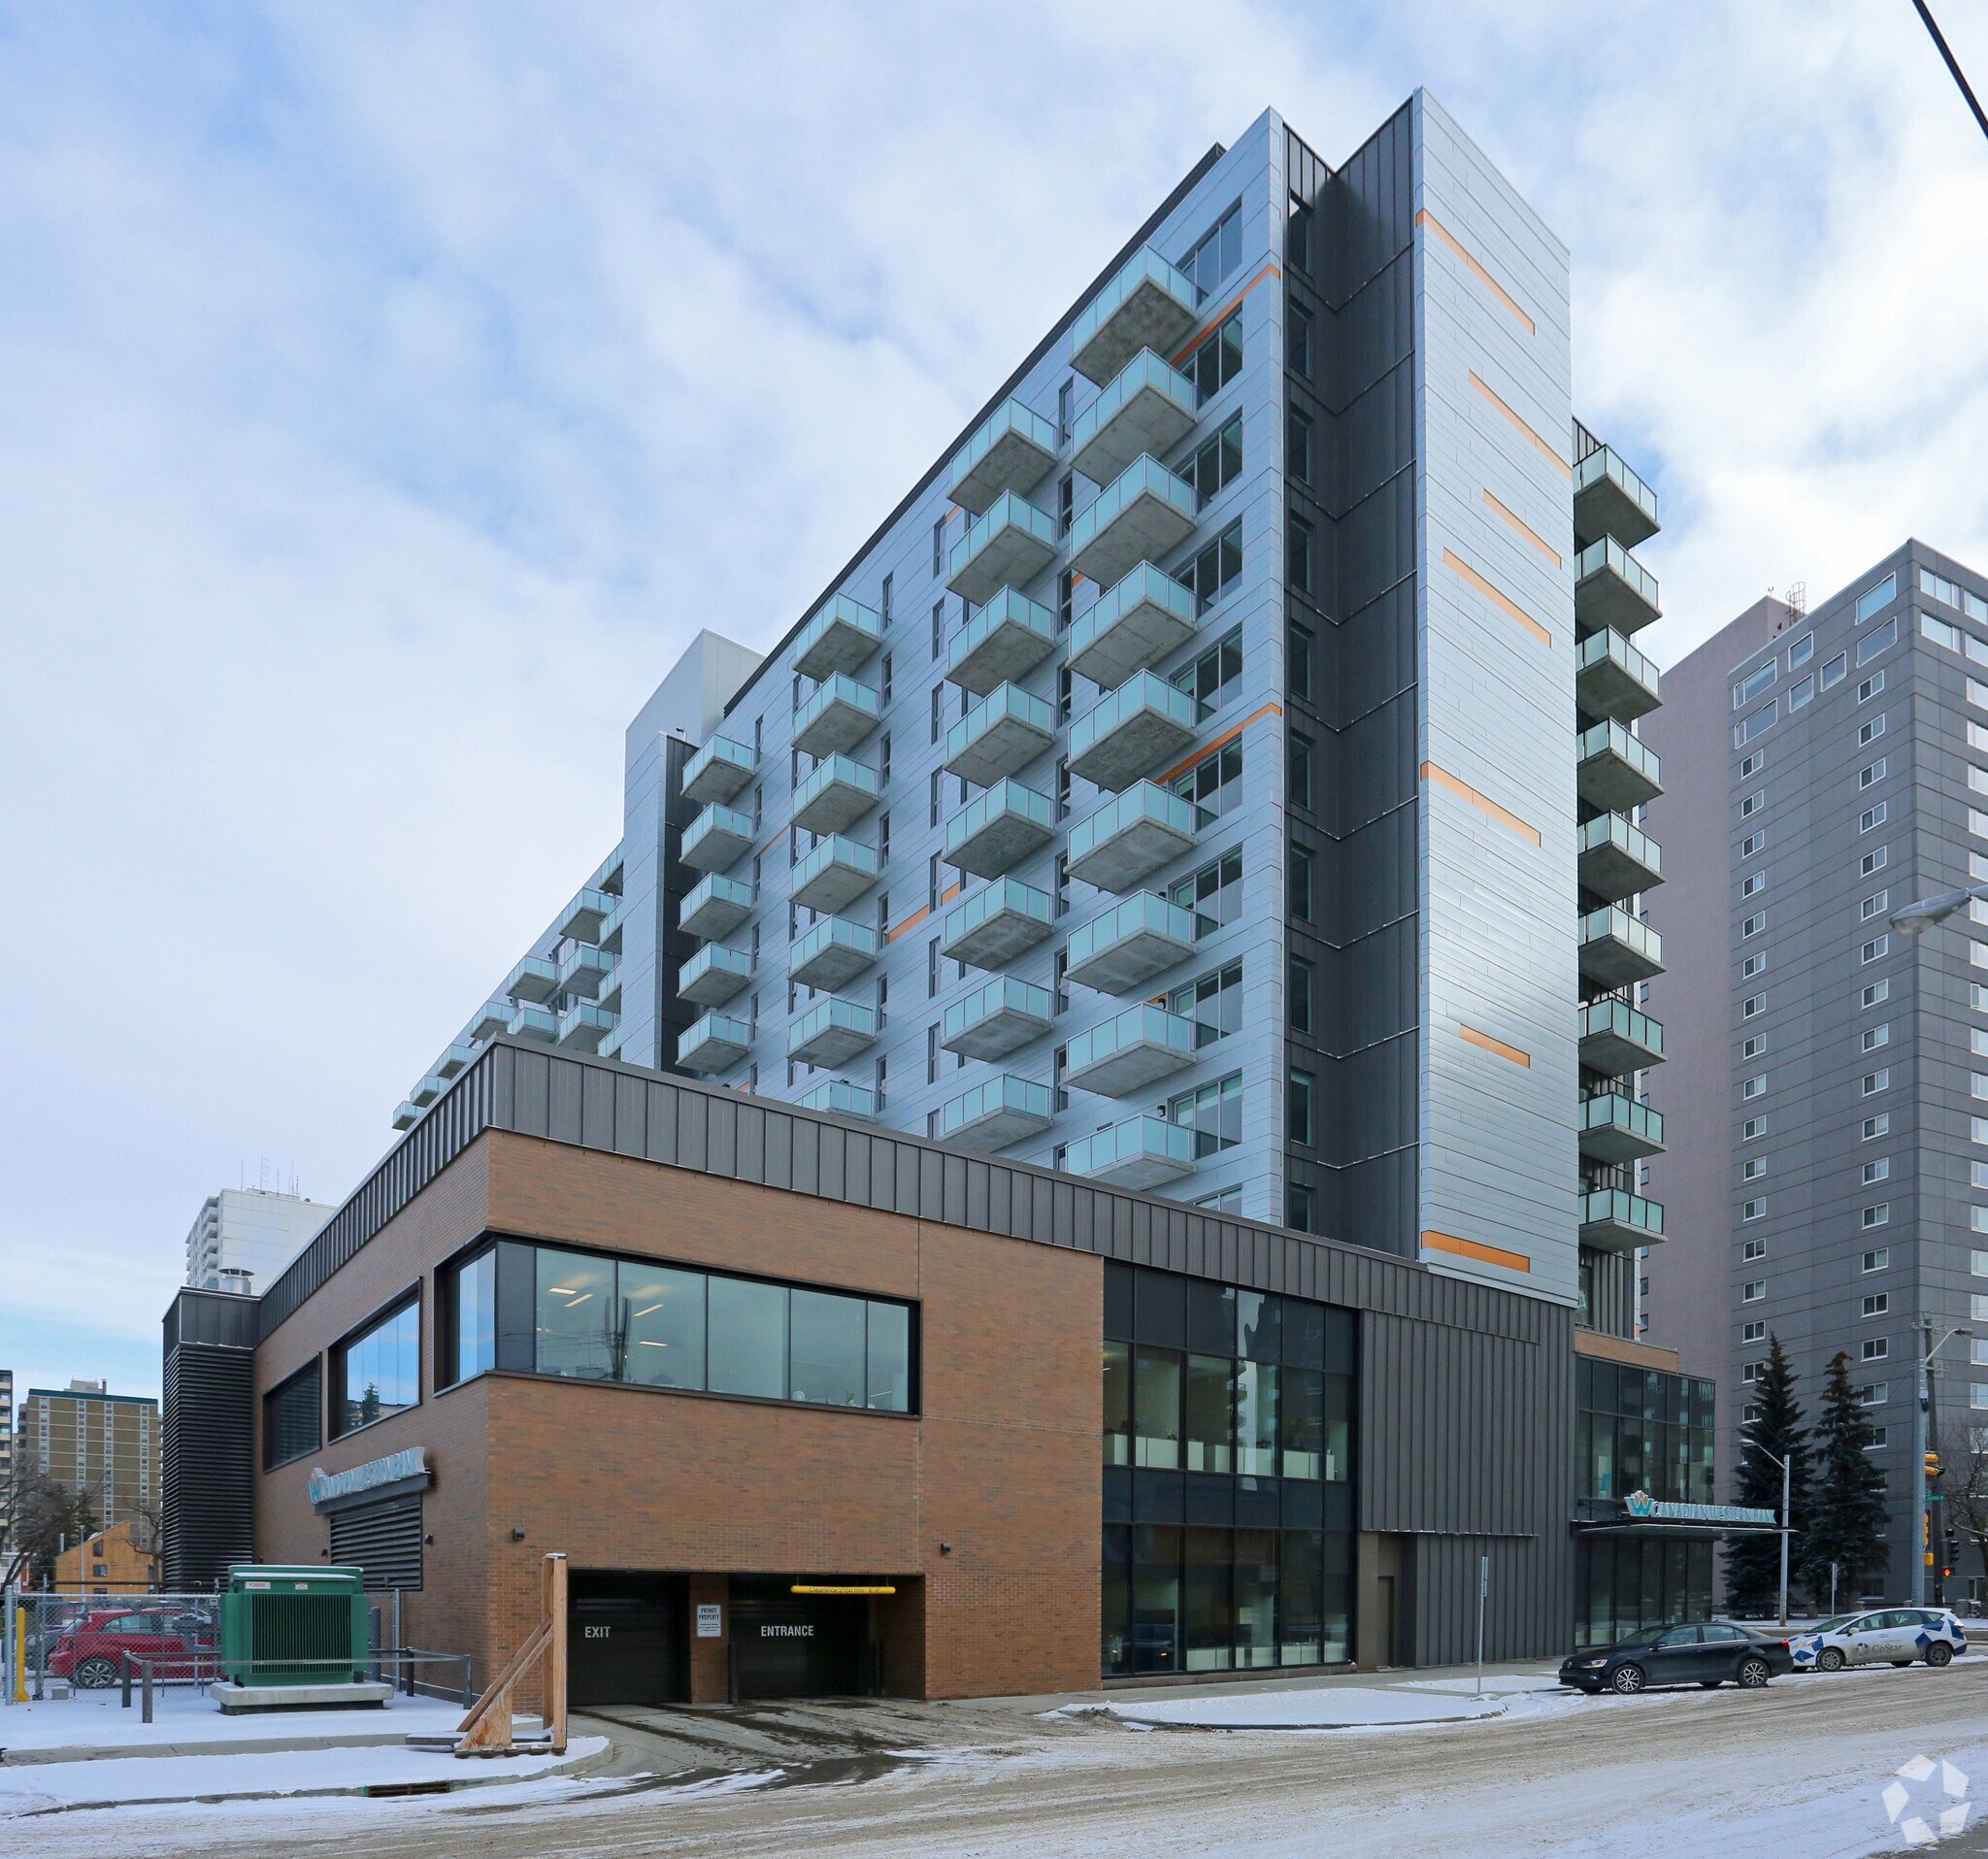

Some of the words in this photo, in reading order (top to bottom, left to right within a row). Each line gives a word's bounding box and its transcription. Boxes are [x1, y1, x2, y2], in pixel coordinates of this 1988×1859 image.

[1651, 1501, 1706, 1519] CANADIAN
[1708, 1505, 1751, 1521] WESTERN
[1752, 1508, 1777, 1523] BANK
[584, 1626, 611, 1639] EXIT
[760, 1625, 814, 1637] ENTRANCE
[1872, 1643, 1904, 1653] CoStar
